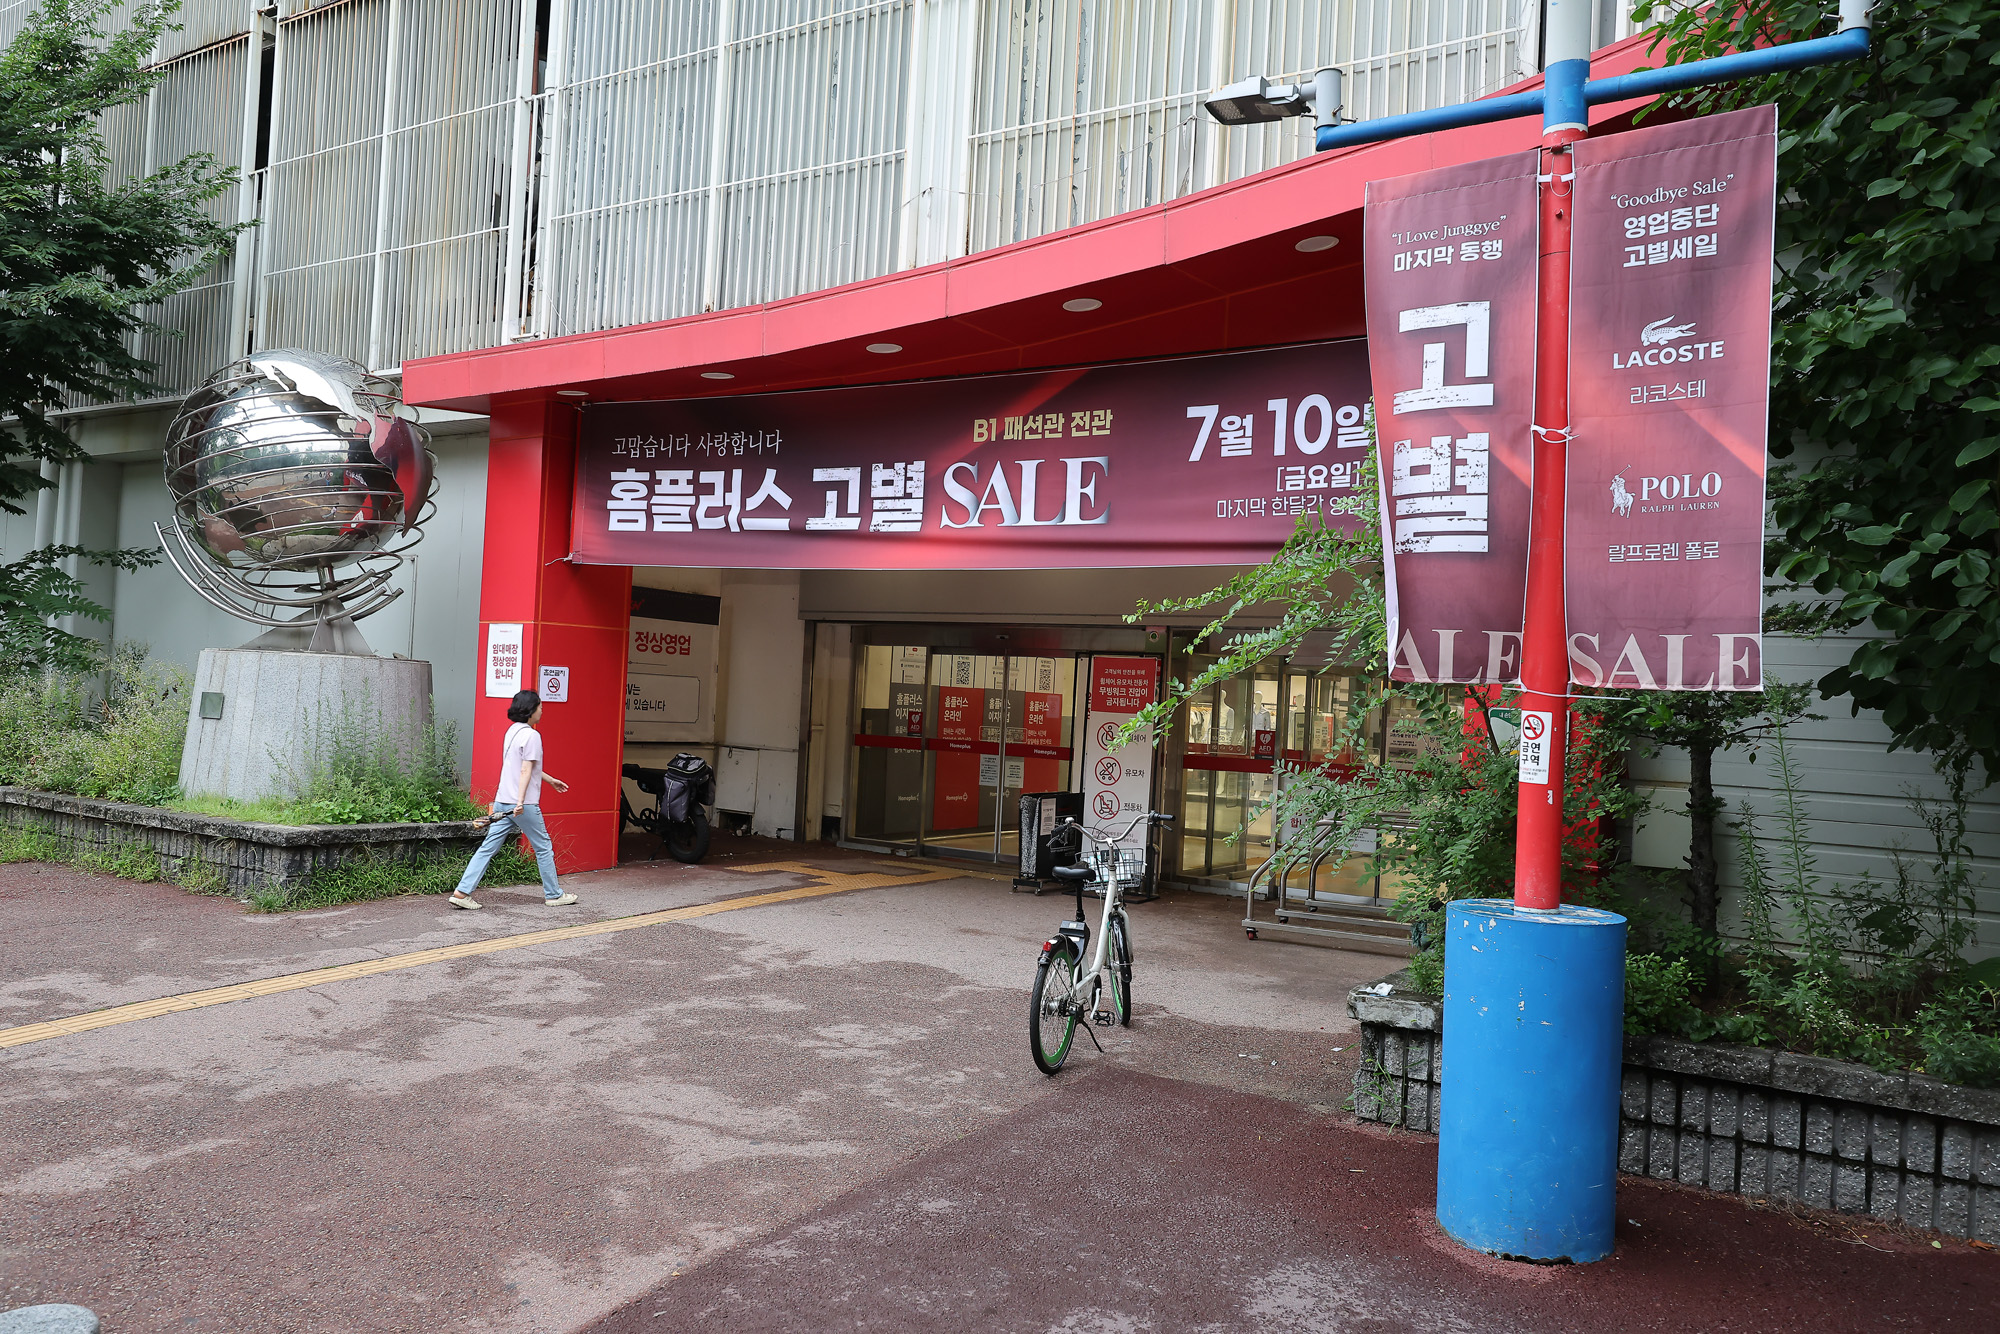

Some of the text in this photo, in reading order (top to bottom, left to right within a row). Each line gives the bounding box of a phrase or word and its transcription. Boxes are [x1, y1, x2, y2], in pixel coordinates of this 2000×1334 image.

[1623, 203, 1720, 240] 영업중단
[1406, 227, 1439, 243] Love
[1393, 239, 1504, 274] 마지막 동행
[1623, 233, 1719, 269] 고별세일
[1613, 340, 1726, 371] LACOSTE
[1629, 379, 1707, 405] 라코스테
[973, 409, 1114, 443] B1 패션관 전관
[1186, 393, 1373, 463] 7월 10일
[610, 427, 783, 459] 고맙습니다 사랑합니다
[1276, 460, 1361, 492] [금요일]
[1640, 471, 1723, 501] POLO
[605, 456, 1111, 533] 홈플러스 고별 SALE
[1216, 497, 1267, 519] 마지막
[1271, 494, 1325, 517] 한달간
[1641, 500, 1721, 513] RALPH LAUREN
[1608, 541, 1720, 563] 랄프로렌 폴로
[492, 643, 519, 655] 임대매장
[634, 631, 691, 656] 정상영업
[492, 656, 518, 668] 정상영업
[1392, 628, 1522, 684] ALE
[1568, 632, 1762, 692] SALE
[494, 668, 514, 680] 합니다
[543, 668, 566, 677] 흡연금지
[625, 683, 641, 696] V는
[1099, 687, 1148, 697] 무빙워크 진입이
[633, 698, 666, 713] 있습니다
[896, 693, 923, 706] 홈플러스
[944, 696, 969, 708] 홈플러스
[1029, 701, 1050, 712] 홈플러스
[1105, 698, 1140, 708] 금지됩니다
[944, 710, 962, 722] 온라인
[1028, 714, 1044, 725] 온라인
[949, 742, 972, 750] Homeplus
[1522, 741, 1541, 754] 금연
[1521, 753, 1541, 766] 구역
[1124, 768, 1145, 778] 유모차
[1123, 802, 1143, 812] 전동차
